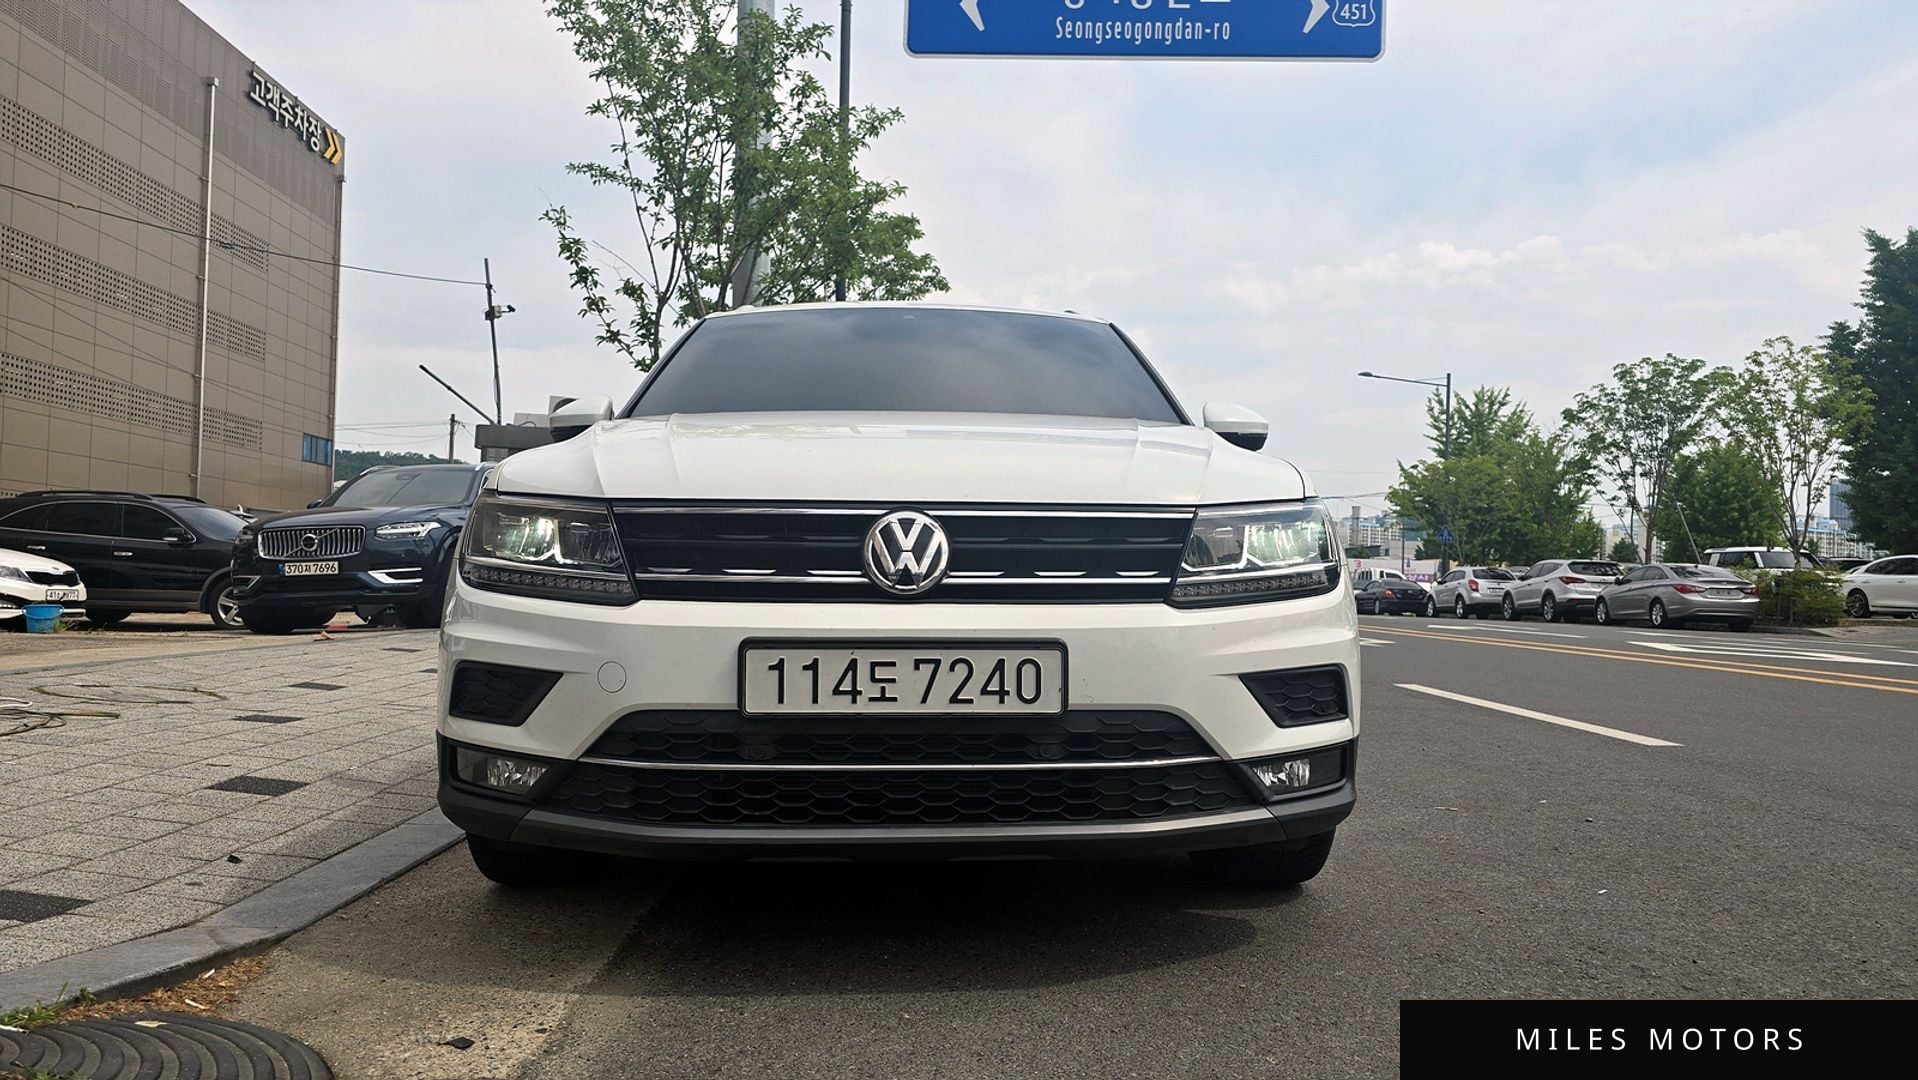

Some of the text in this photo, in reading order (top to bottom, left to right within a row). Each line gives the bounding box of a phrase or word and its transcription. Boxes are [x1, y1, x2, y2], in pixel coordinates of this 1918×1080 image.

[1340, 3, 1367, 20] 451
[1055, 16, 1231, 45] Seongseogongdan-ro
[250, 71, 322, 152] 고객주차장
